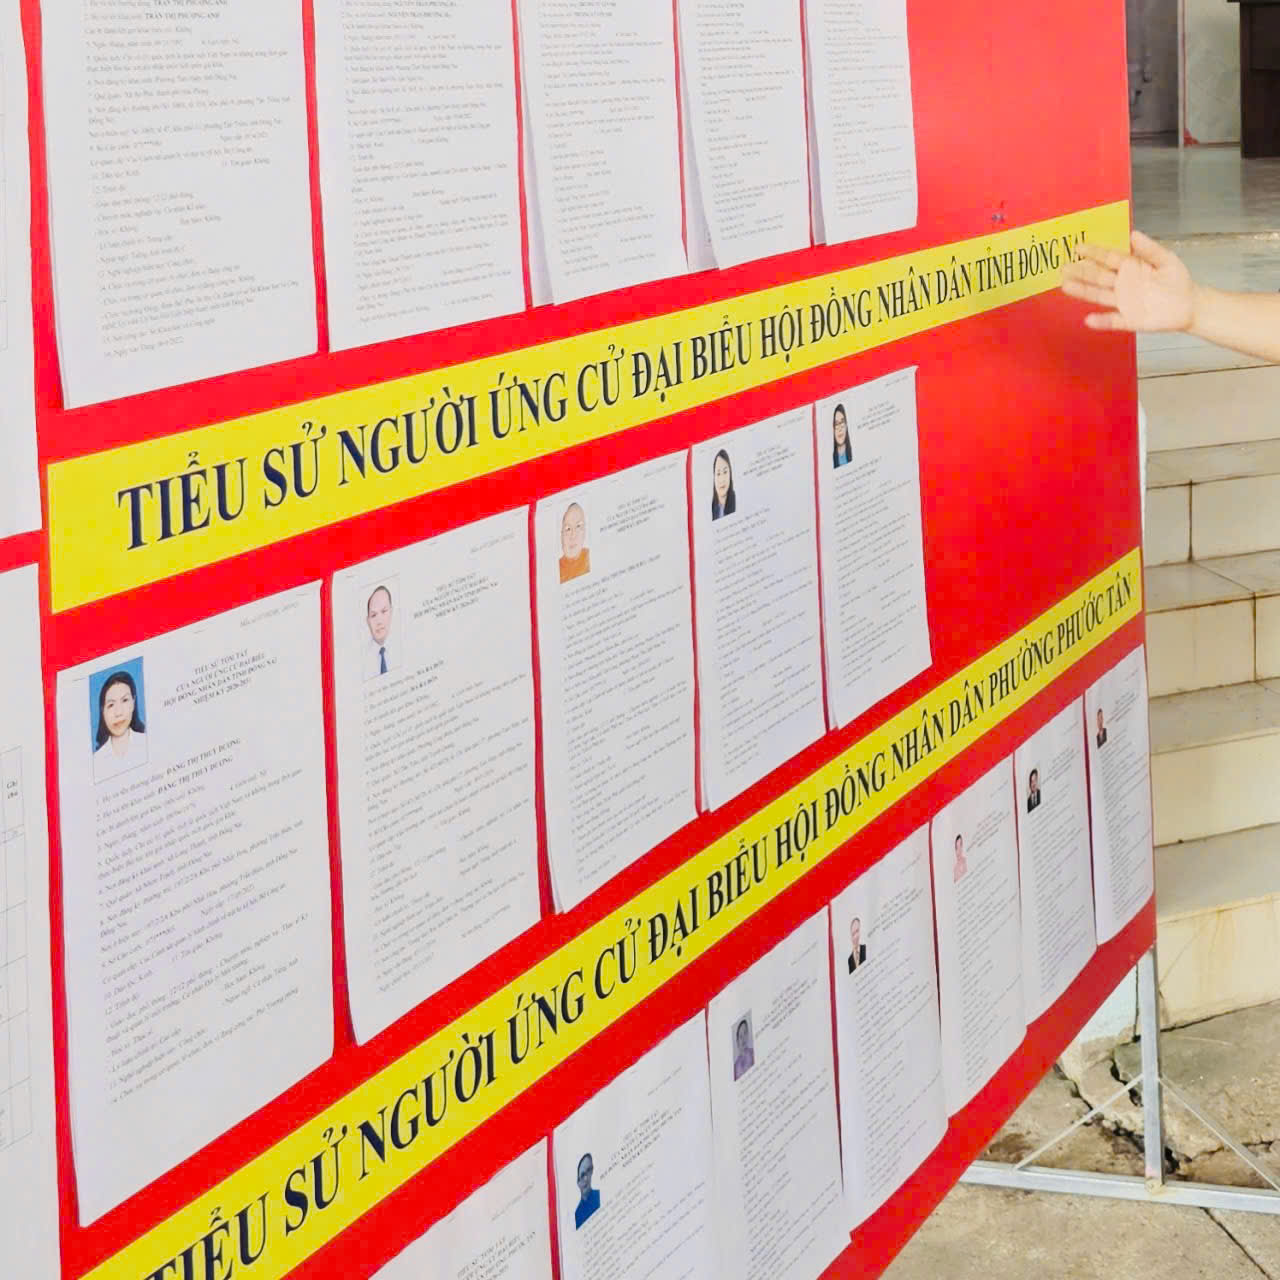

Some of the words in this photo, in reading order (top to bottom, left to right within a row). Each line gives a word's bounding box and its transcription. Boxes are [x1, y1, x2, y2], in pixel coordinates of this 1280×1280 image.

[117, 450, 246, 550] TIỂU
[263, 421, 327, 508] SỬ
[337, 386, 478, 486] NGƯỜI
[488, 372, 567, 439] ỨNG
[577, 344, 624, 412] CỬ
[631, 341, 682, 403] ĐẠI
[690, 314, 752, 380] BIỂU
[759, 305, 804, 367] HỘI
[810, 284, 872, 344] ĐỒNG
[877, 265, 932, 326] NHÂN
[936, 255, 972, 308] DÂN
[976, 246, 1014, 293] TỈNH
[1018, 235, 1060, 281] ĐỒNG
[143, 1190, 271, 1280] IỂU
[284, 1124, 349, 1237] SỬ
[357, 1031, 497, 1181] NGƯỜI
[506, 969, 586, 1065] ỨNG
[594, 915, 642, 1000] CỬ
[648, 887, 700, 967] ĐẠI
[707, 825, 770, 921] BIỂU
[775, 801, 819, 864] HỘI
[825, 753, 885, 830] ĐỒNG
[891, 708, 945, 780] NHÂN
[949, 679, 985, 737] DÂN
[988, 630, 1054, 709] PHƯỜNG
[1057, 591, 1104, 664] PHƯỚC
[1105, 571, 1133, 617] TÂN
